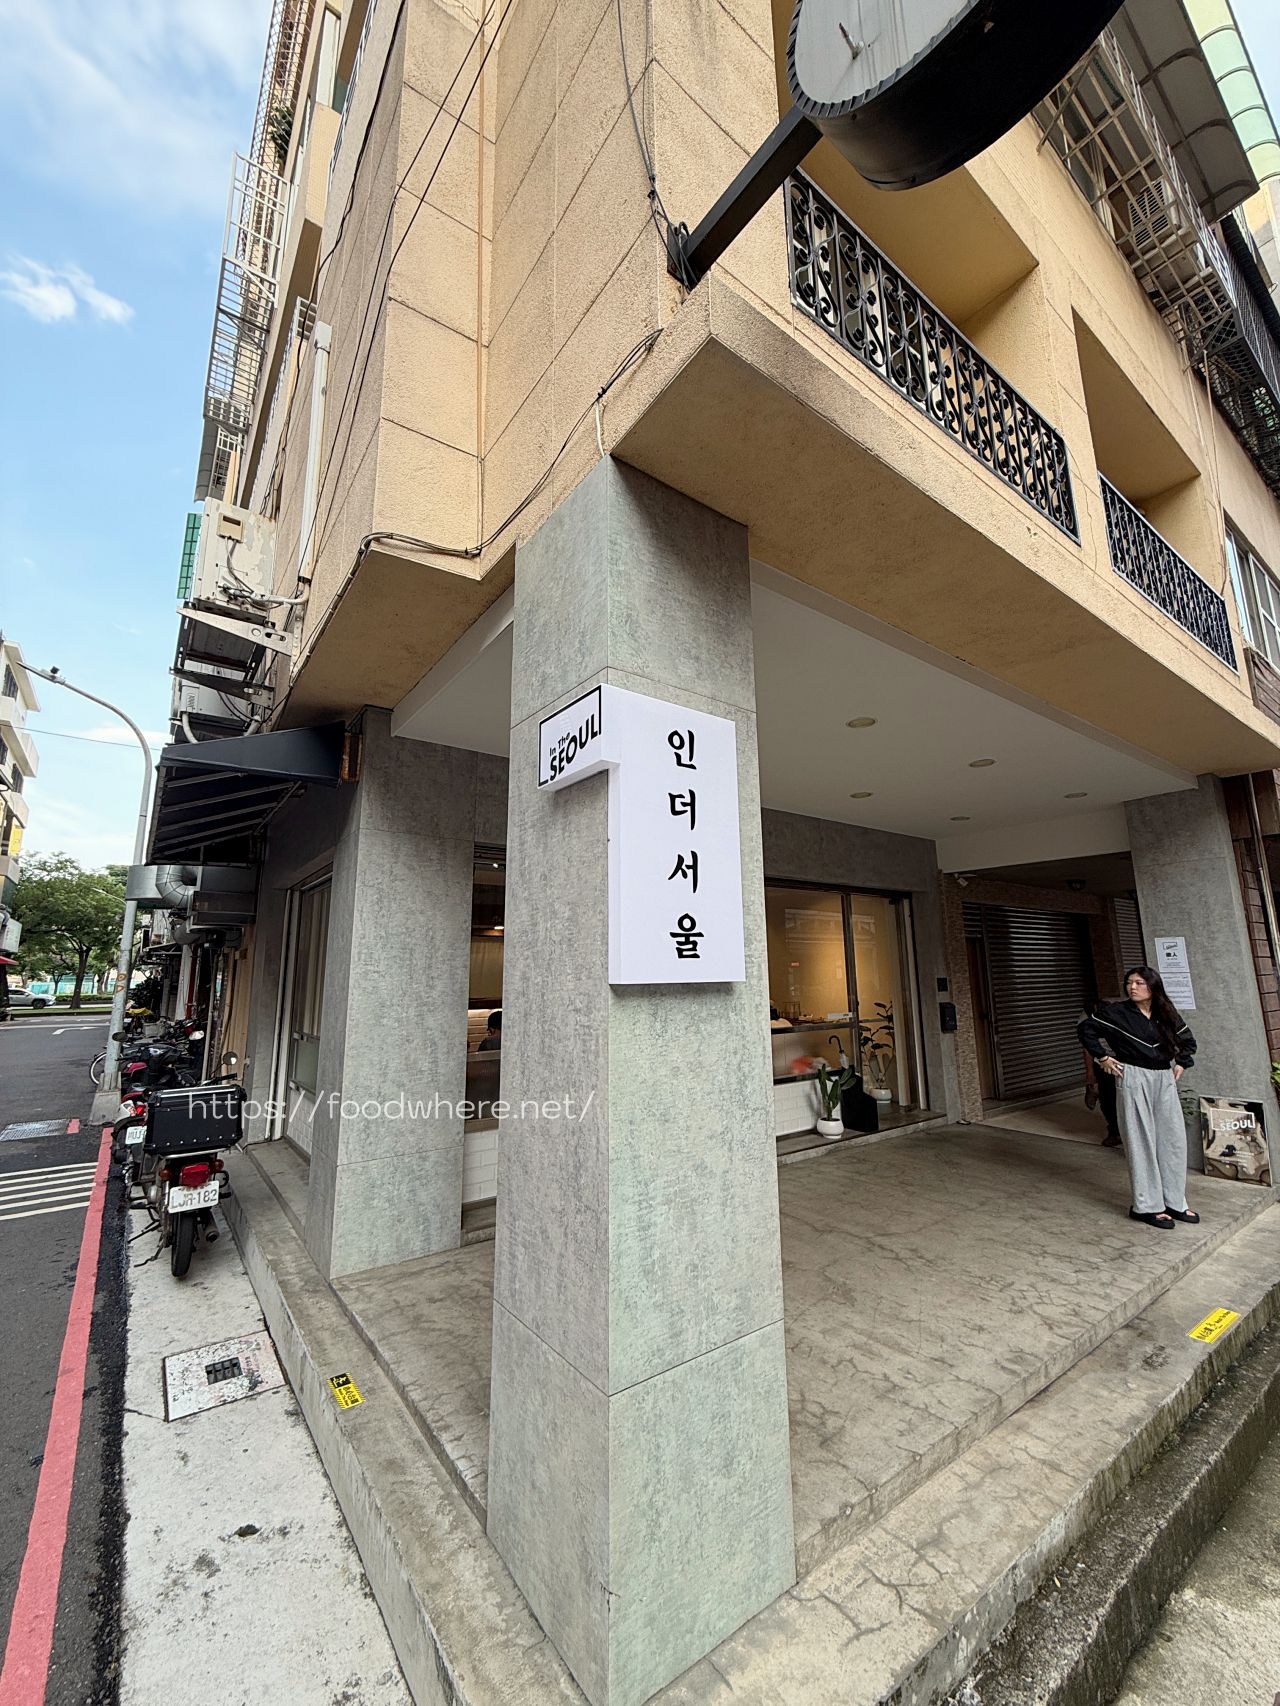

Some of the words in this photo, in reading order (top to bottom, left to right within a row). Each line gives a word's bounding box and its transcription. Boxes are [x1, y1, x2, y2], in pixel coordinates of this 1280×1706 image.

[549, 747, 557, 757] In
[558, 732, 570, 749] The
[549, 713, 599, 782] SEOUL
[667, 729, 705, 959] 인더서울
[1220, 1119, 1253, 1131] SEOUL
